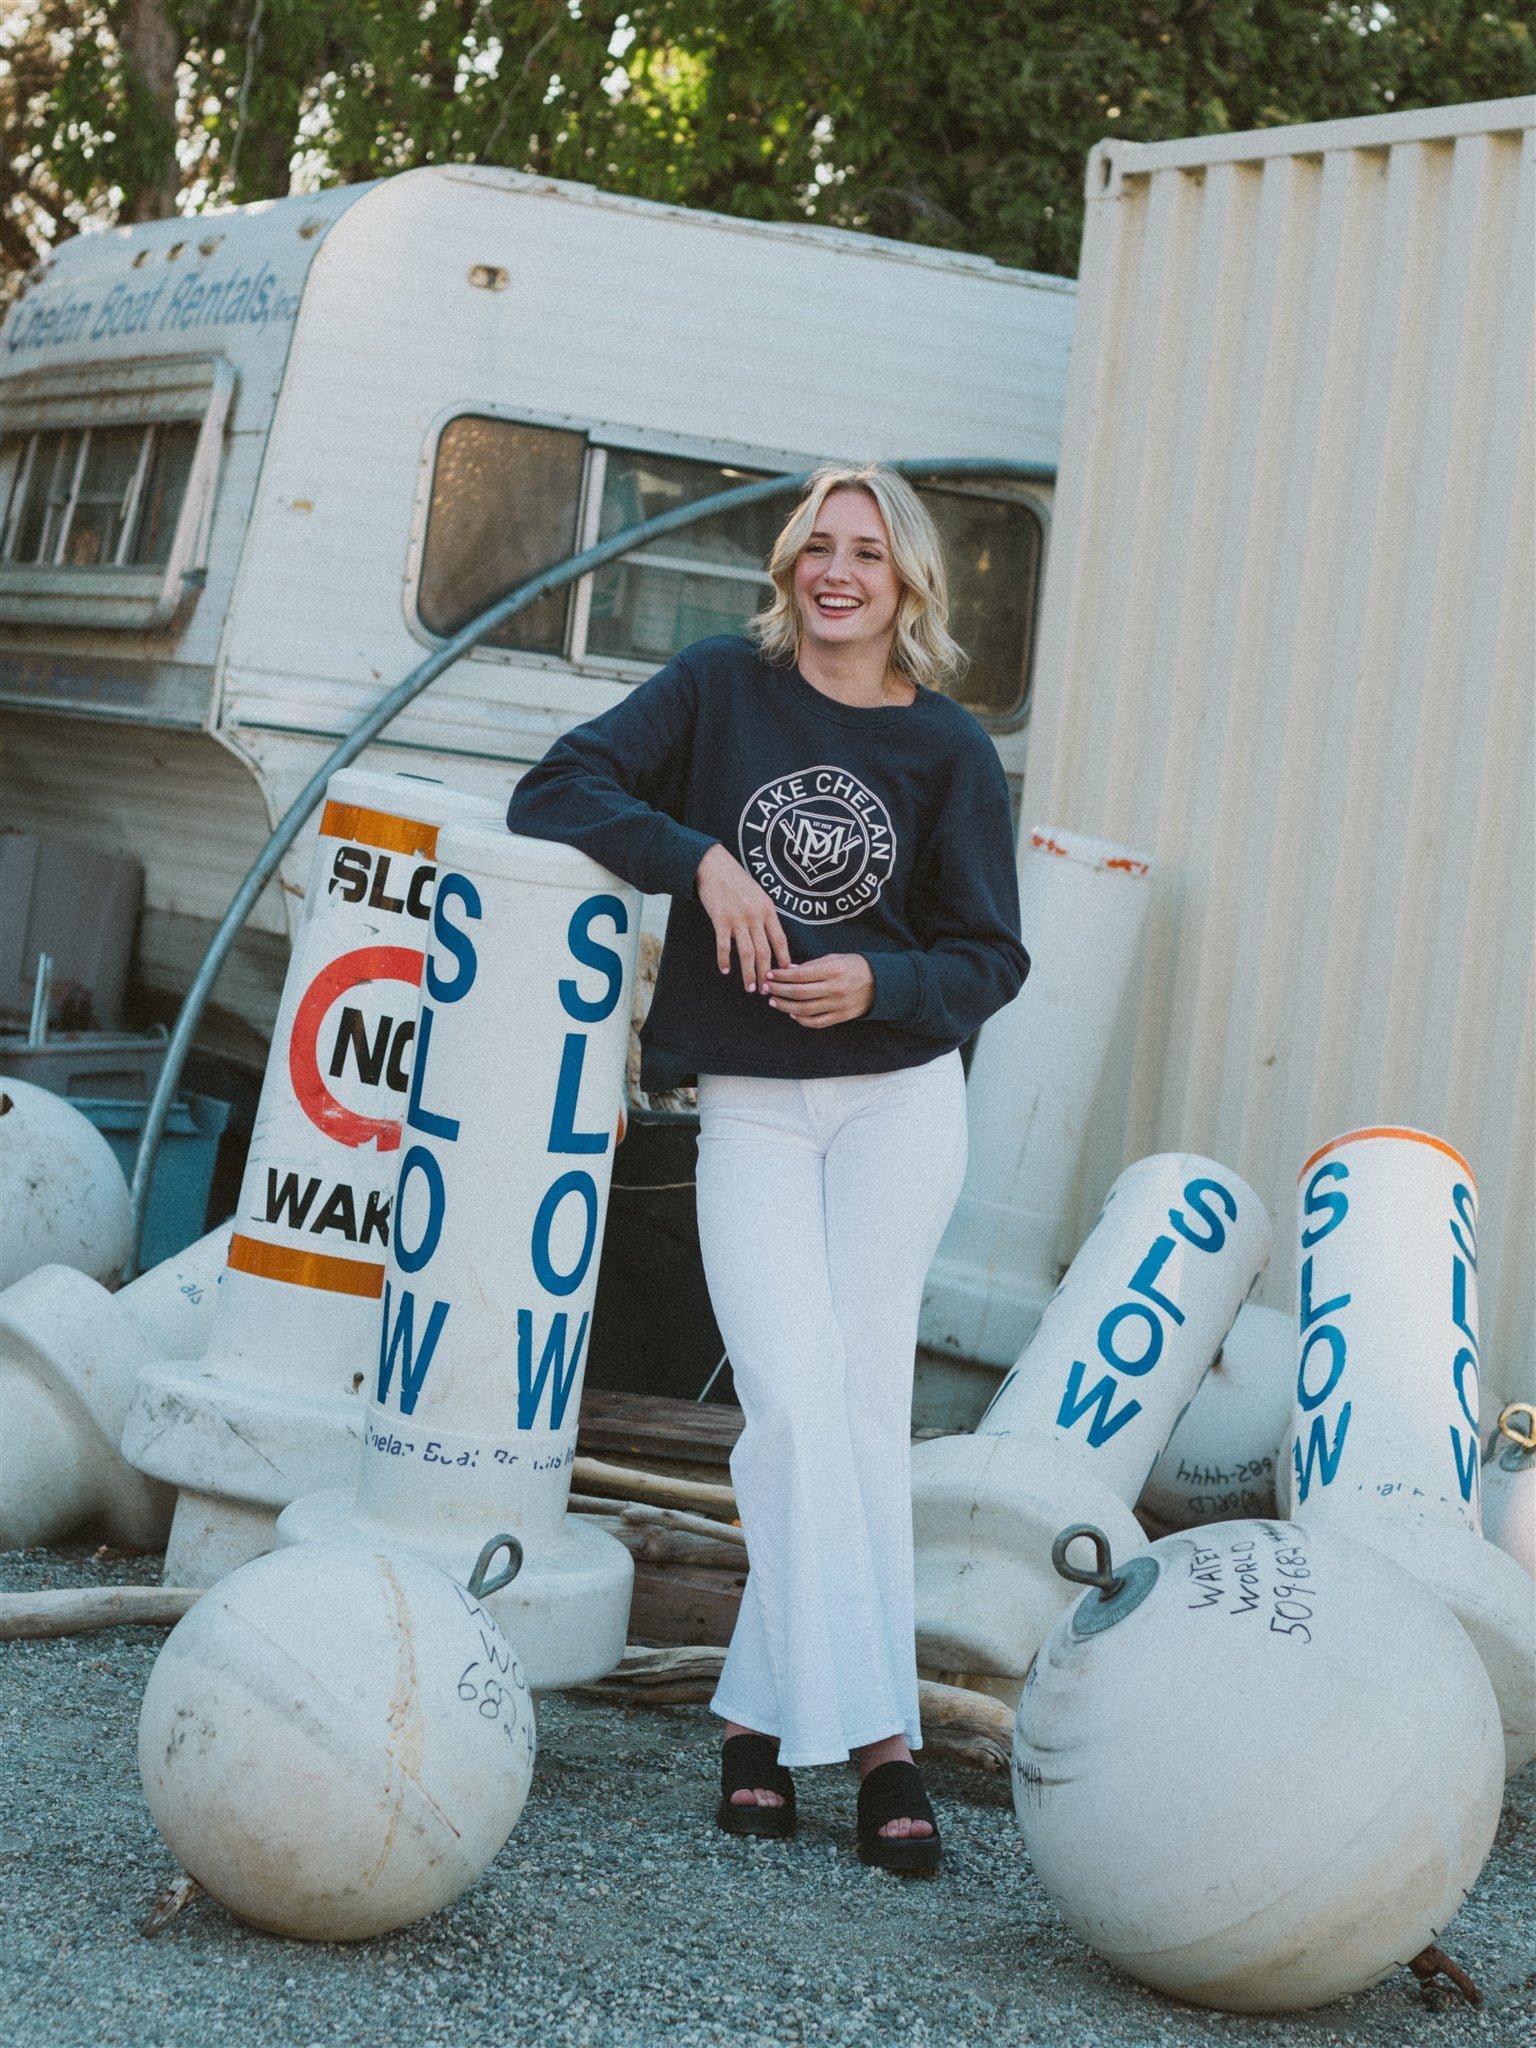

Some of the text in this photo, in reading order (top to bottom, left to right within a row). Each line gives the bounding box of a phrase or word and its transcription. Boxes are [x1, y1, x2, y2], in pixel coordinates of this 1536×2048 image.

[90, 274, 169, 341] Boat
[745, 772, 892, 861] LAKE CHELAN
[748, 845, 879, 916] VACATION CLUB
[377, 872, 482, 1417] SLOW
[516, 894, 628, 1431] SLOW
[1056, 1178, 1238, 1450] SLOW
[1294, 1161, 1351, 1505] SLOW
[1230, 1541, 1260, 1615] WORLD
